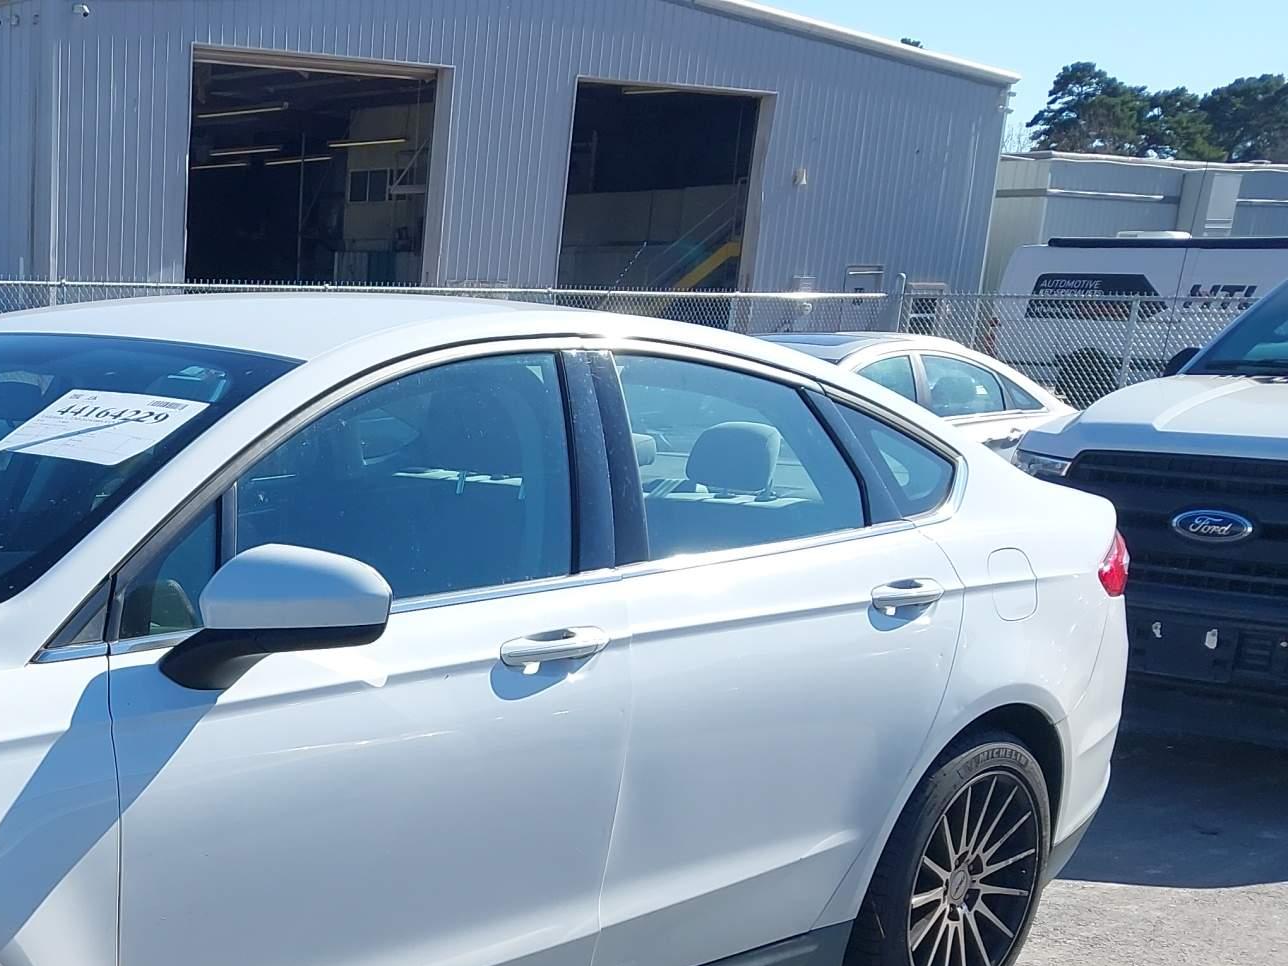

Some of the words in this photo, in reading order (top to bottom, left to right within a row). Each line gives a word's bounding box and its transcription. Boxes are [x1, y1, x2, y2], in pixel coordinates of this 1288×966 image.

[1040, 279, 1103, 288] AUTOMOTIVE
[57, 404, 170, 424] 44164229
[1189, 516, 1232, 535] Ford
[979, 749, 1028, 767] MICHELIN
